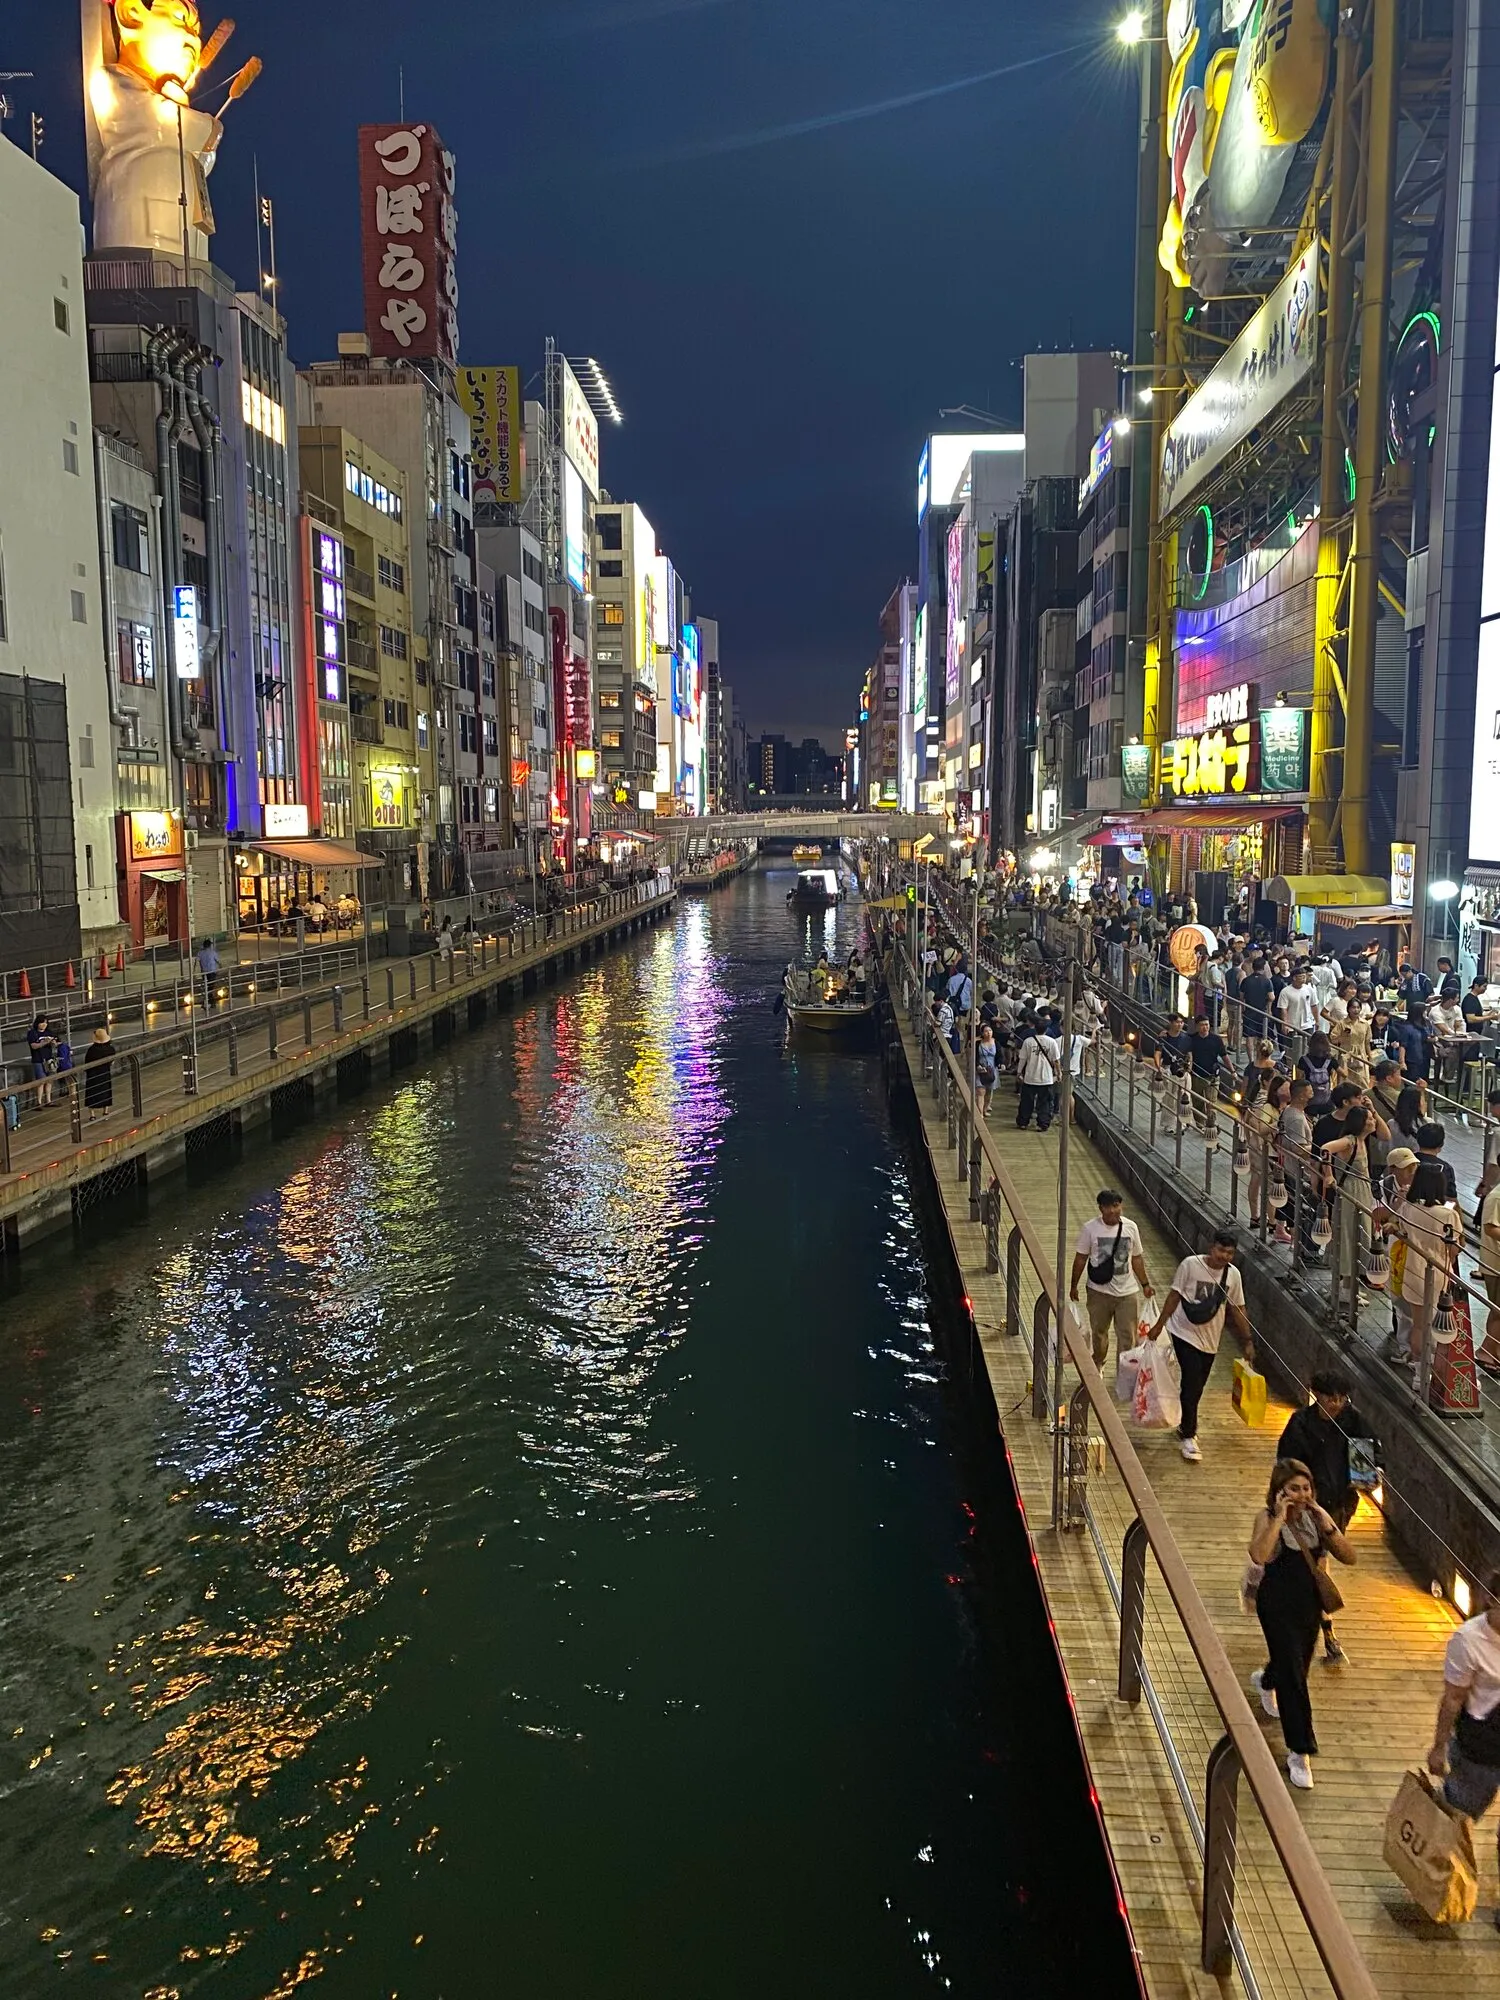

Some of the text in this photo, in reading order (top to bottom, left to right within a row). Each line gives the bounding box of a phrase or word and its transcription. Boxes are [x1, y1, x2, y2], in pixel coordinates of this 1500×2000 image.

[374, 124, 430, 347] づぼらや
[466, 371, 494, 479] いちごなび
[1401, 1819, 1428, 1857] GU
